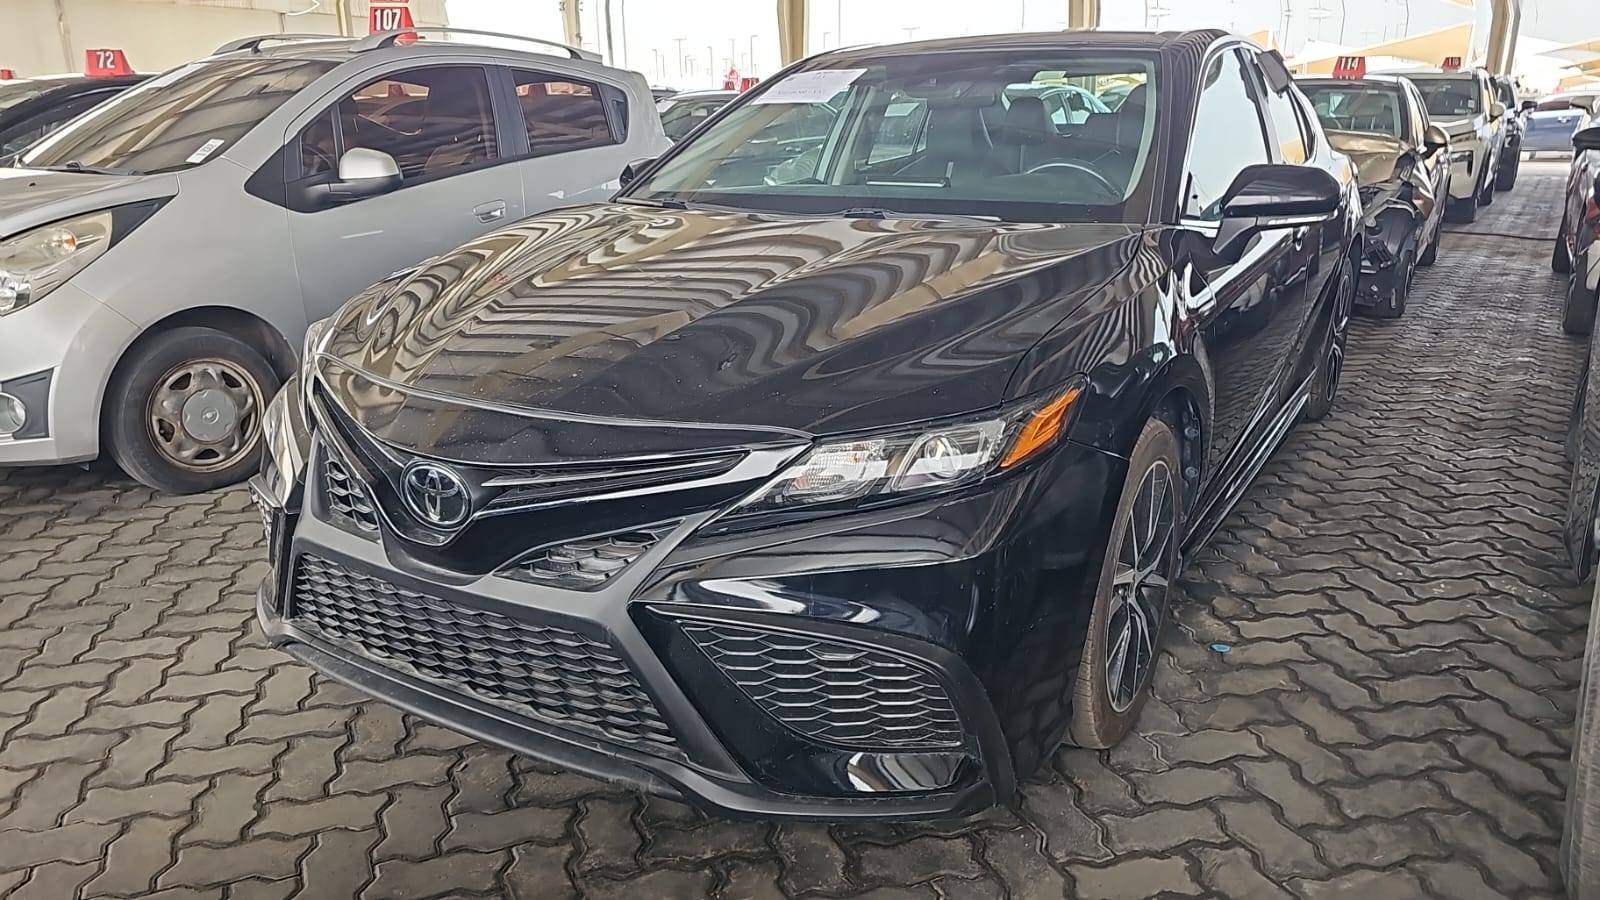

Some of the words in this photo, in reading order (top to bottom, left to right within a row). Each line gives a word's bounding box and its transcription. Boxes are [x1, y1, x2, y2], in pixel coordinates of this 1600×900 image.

[375, 9, 401, 31] 107
[96, 51, 115, 69] 72
[1341, 57, 1359, 70] 114
